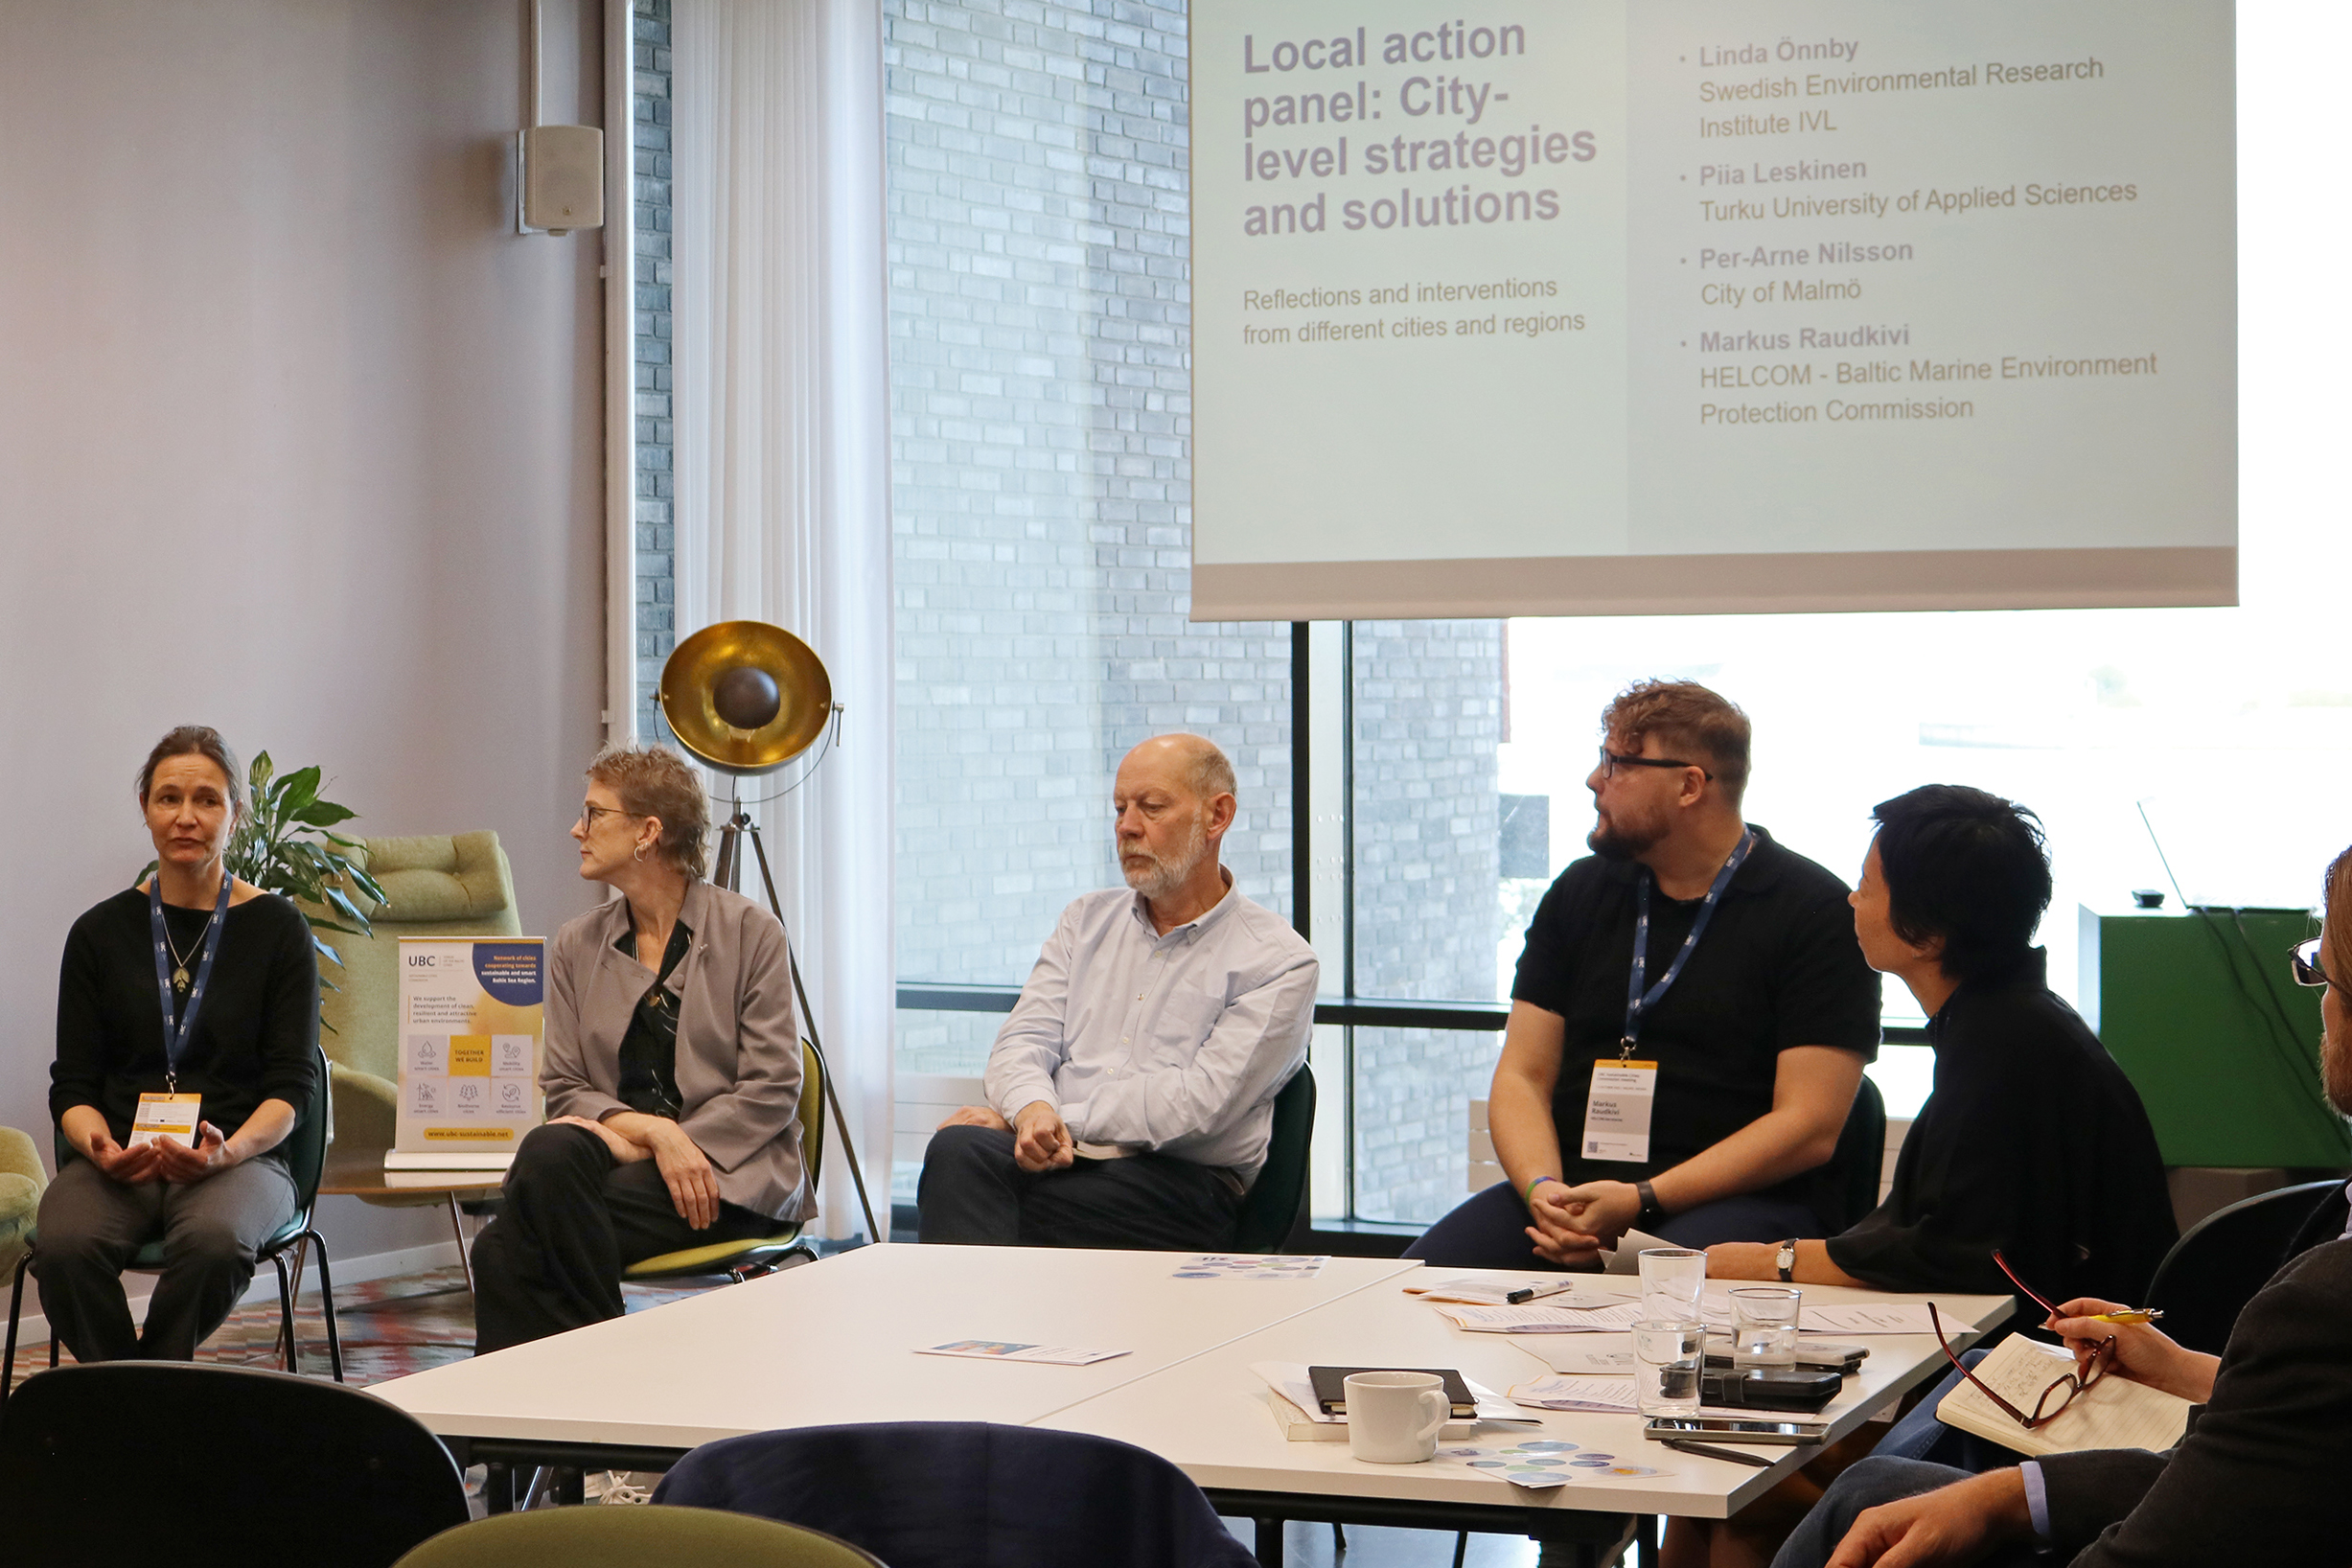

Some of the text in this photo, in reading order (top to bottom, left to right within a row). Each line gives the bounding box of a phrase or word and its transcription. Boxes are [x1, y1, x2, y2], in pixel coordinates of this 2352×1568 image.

[1243, 18, 1525, 74] Local action
[1699, 35, 1858, 67] Linda Önnby
[1698, 56, 2104, 103] Swedish Environmental Research
[1243, 75, 1510, 138] panel: City-
[1699, 109, 1837, 138] Institute IVL
[1244, 124, 1597, 181] level strategies
[1699, 158, 1867, 186] Piia Leskinen
[1243, 183, 1560, 237] and solutions
[1698, 182, 2137, 221] Turku University of Applied Sciences
[1699, 241, 1913, 269] Per-Arne Nilsson
[1243, 277, 1557, 311] Reflections and interventions
[1700, 277, 1861, 309] City of Malmö
[1242, 311, 1585, 344] from different cities and regions
[1699, 323, 1909, 353] Markus Raudkivi
[1699, 362, 1811, 388] HELCOM
[1835, 360, 1902, 384] Baltic
[1908, 357, 1993, 381] Marine
[2000, 352, 2157, 380] Environment
[1700, 396, 1973, 425] Protection Commission
[408, 956, 436, 967] UBC
